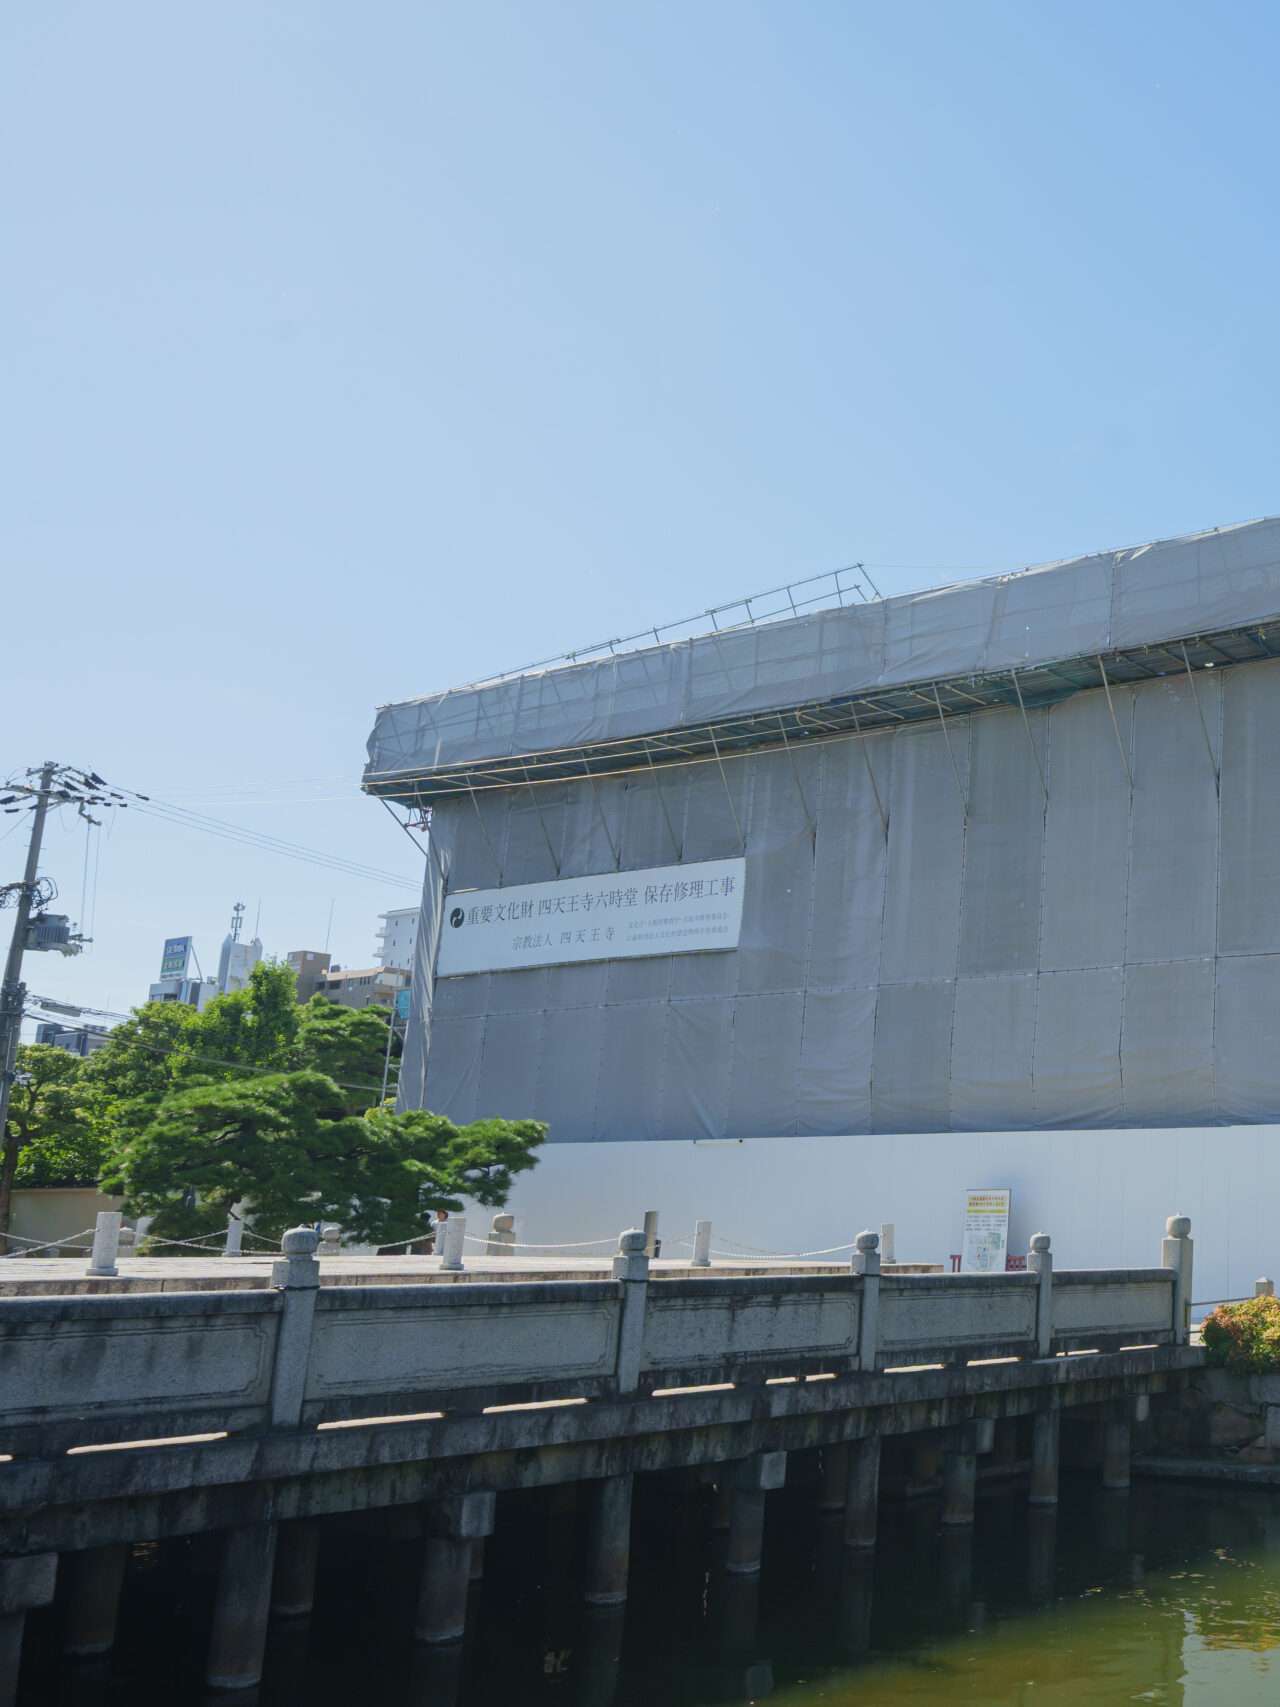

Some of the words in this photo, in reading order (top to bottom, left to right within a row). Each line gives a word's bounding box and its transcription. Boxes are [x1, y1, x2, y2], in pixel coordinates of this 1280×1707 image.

[465, 900, 534, 926] 重要文化財
[538, 887, 639, 916] 四天王寺六時堂
[645, 876, 736, 905] 保存修理工事
[560, 927, 616, 944] 四天王寺
